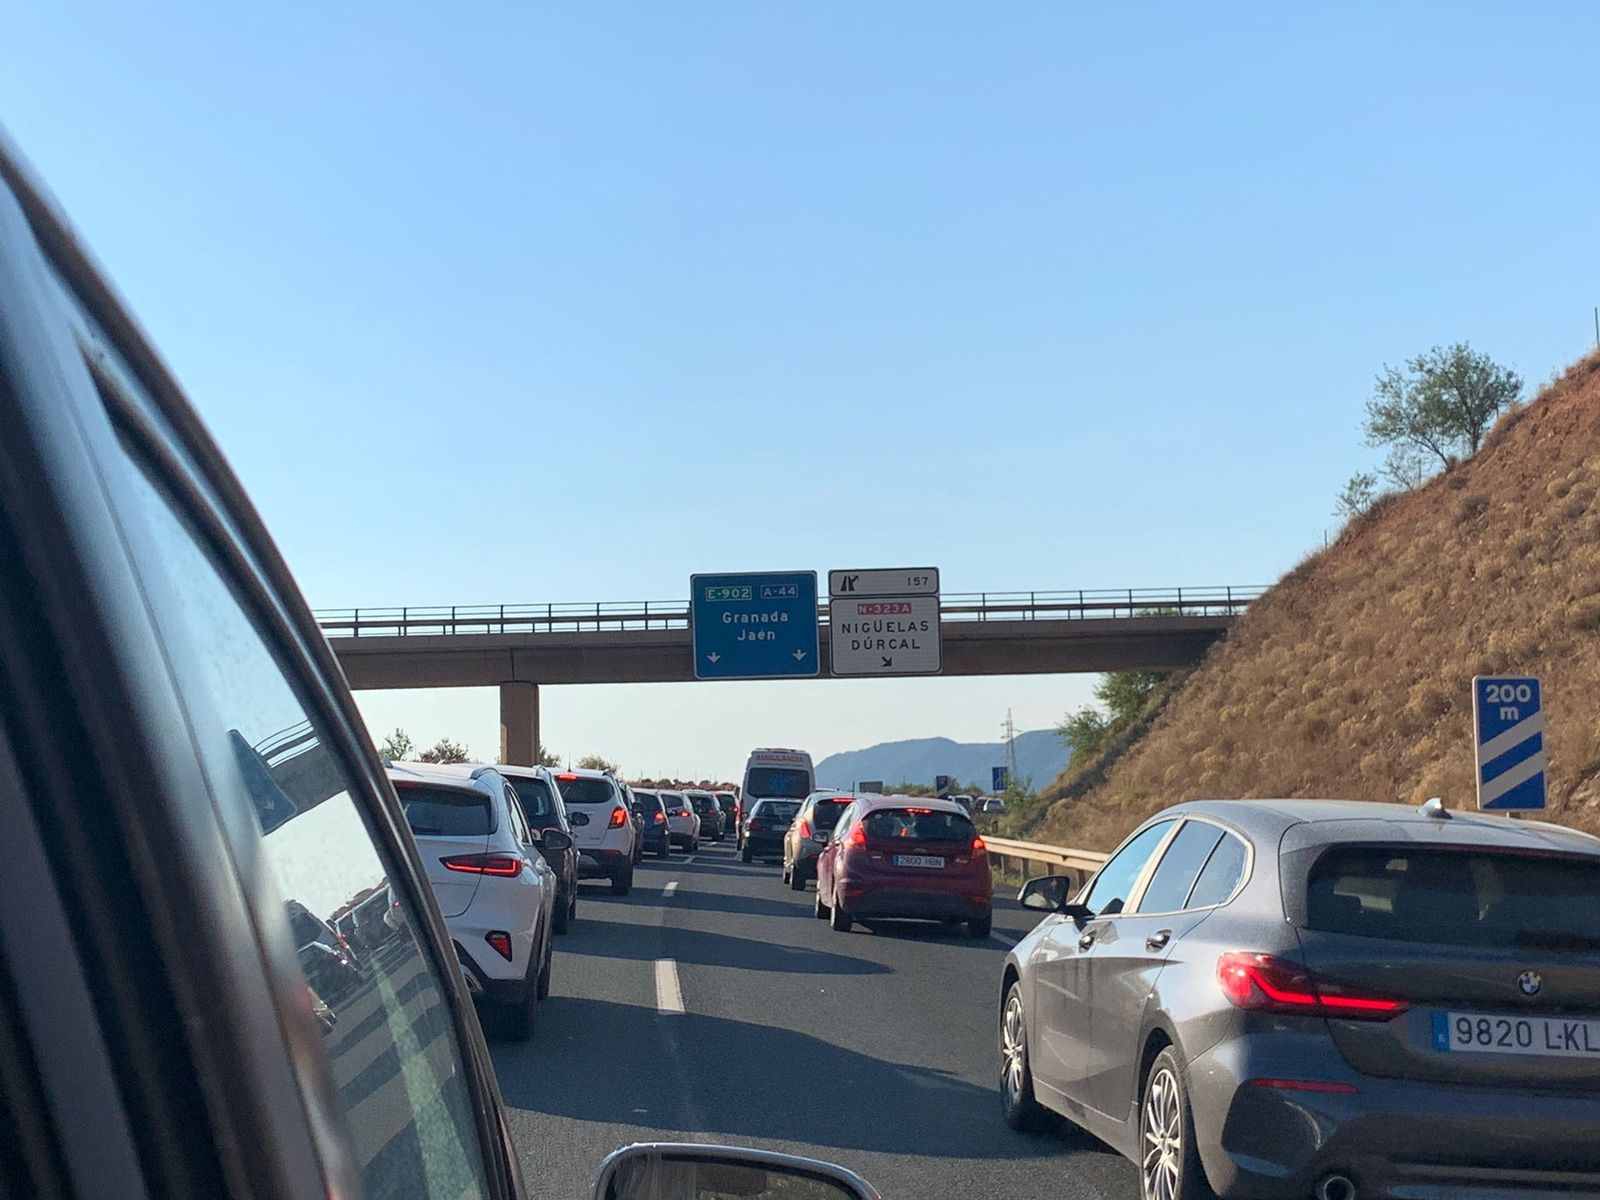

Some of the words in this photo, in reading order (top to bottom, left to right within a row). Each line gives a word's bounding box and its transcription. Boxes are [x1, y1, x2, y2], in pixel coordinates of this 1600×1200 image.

[907, 577, 929, 586] 157
[707, 588, 750, 599] E-902
[763, 586, 796, 596] A-44
[859, 604, 910, 614] N-323A
[722, 611, 789, 623] Granada
[737, 629, 776, 641] Jaén
[851, 636, 921, 650] DÚRCAL
[1485, 684, 1532, 703] 200
[1500, 706, 1519, 720] m
[1456, 1017, 1532, 1048] 9820
[1544, 1021, 1600, 1052] LKL
